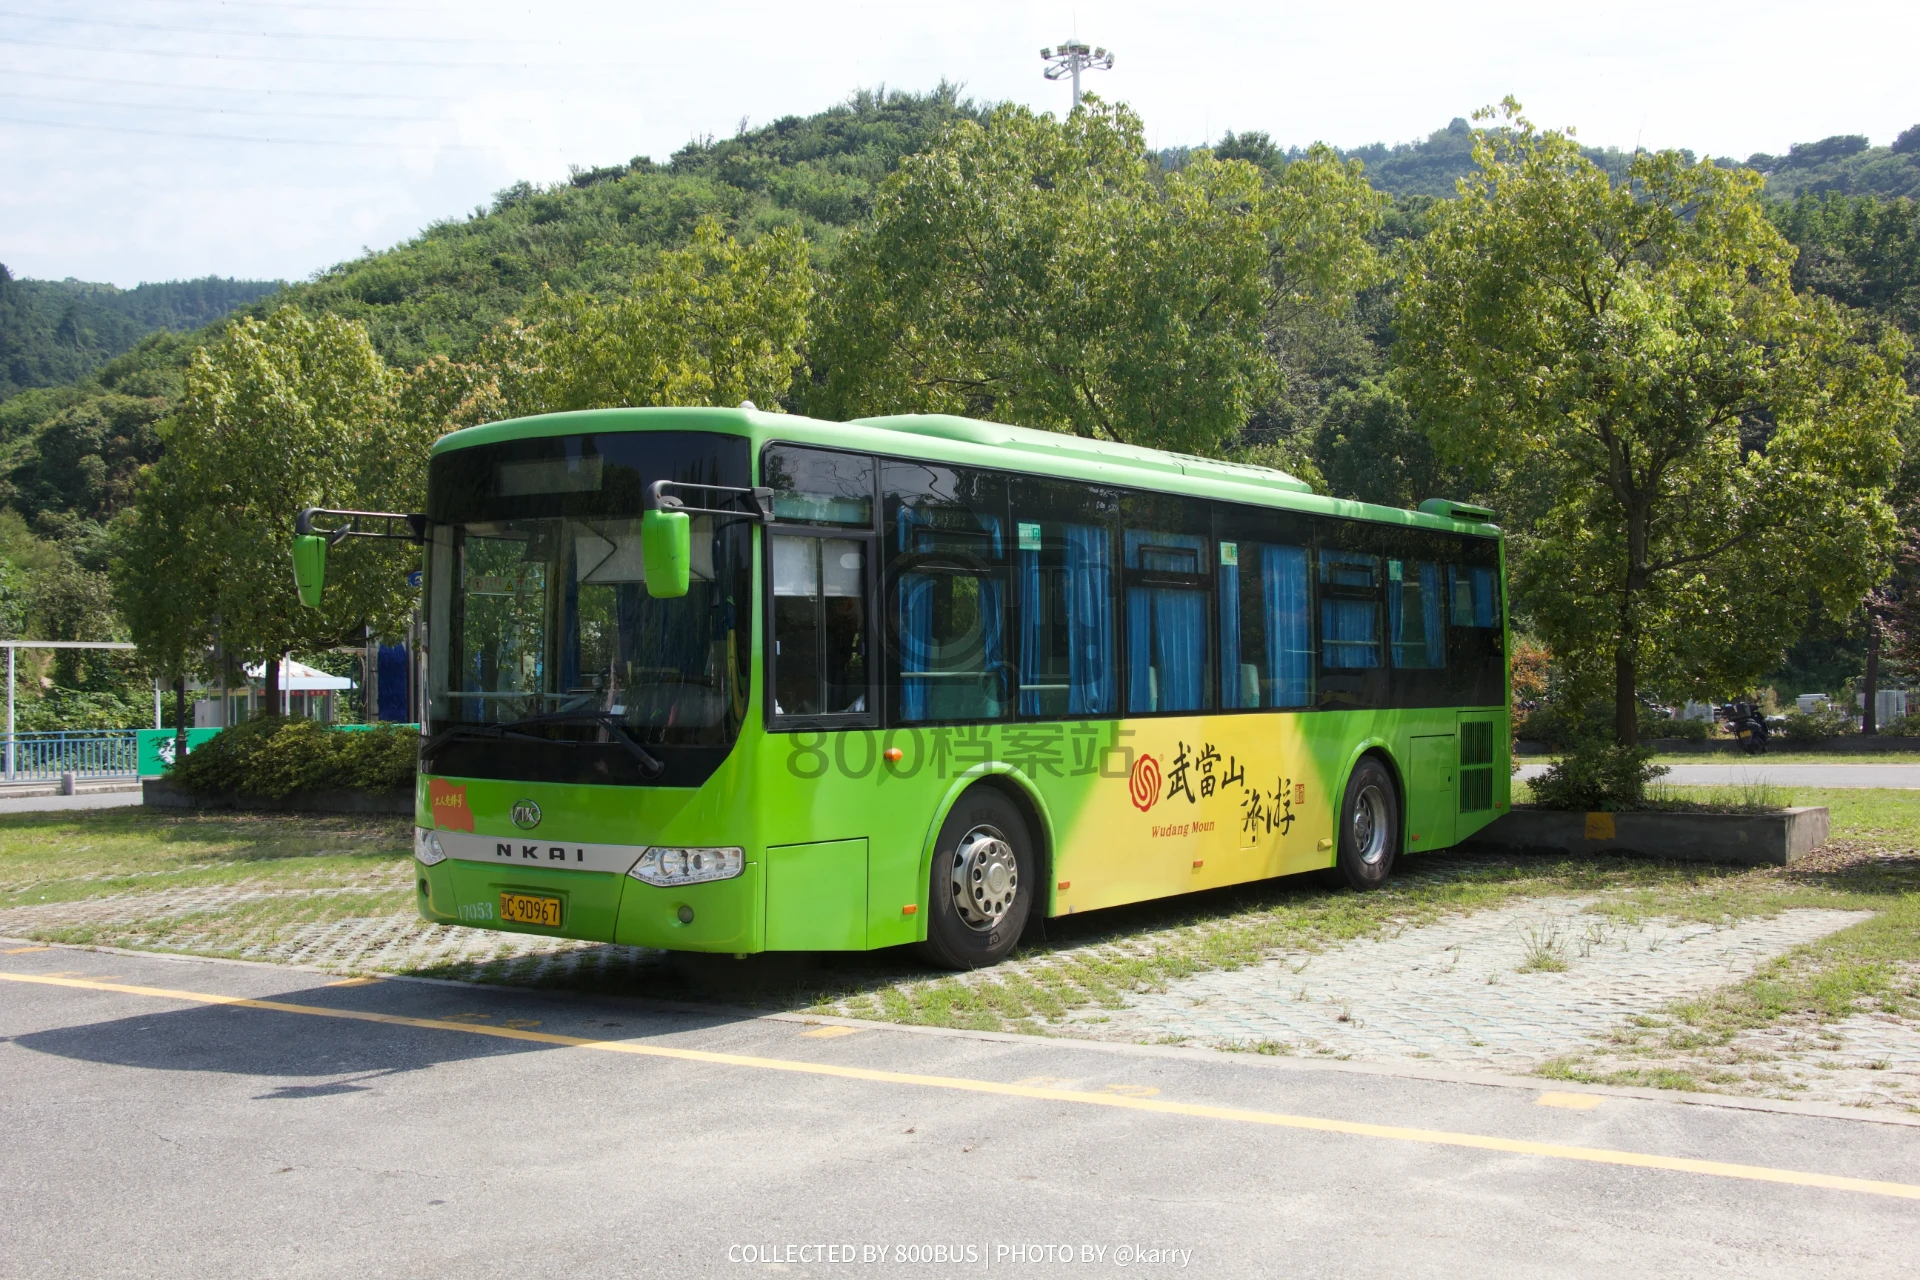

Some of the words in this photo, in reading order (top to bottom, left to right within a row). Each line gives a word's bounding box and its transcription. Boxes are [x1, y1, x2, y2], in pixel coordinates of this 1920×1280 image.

[1166, 740, 1245, 804] 武當山
[1151, 822, 1190, 839] Wudang
[1191, 820, 1215, 834] Moun
[496, 843, 584, 862] NKAI
[457, 902, 493, 921] 17053
